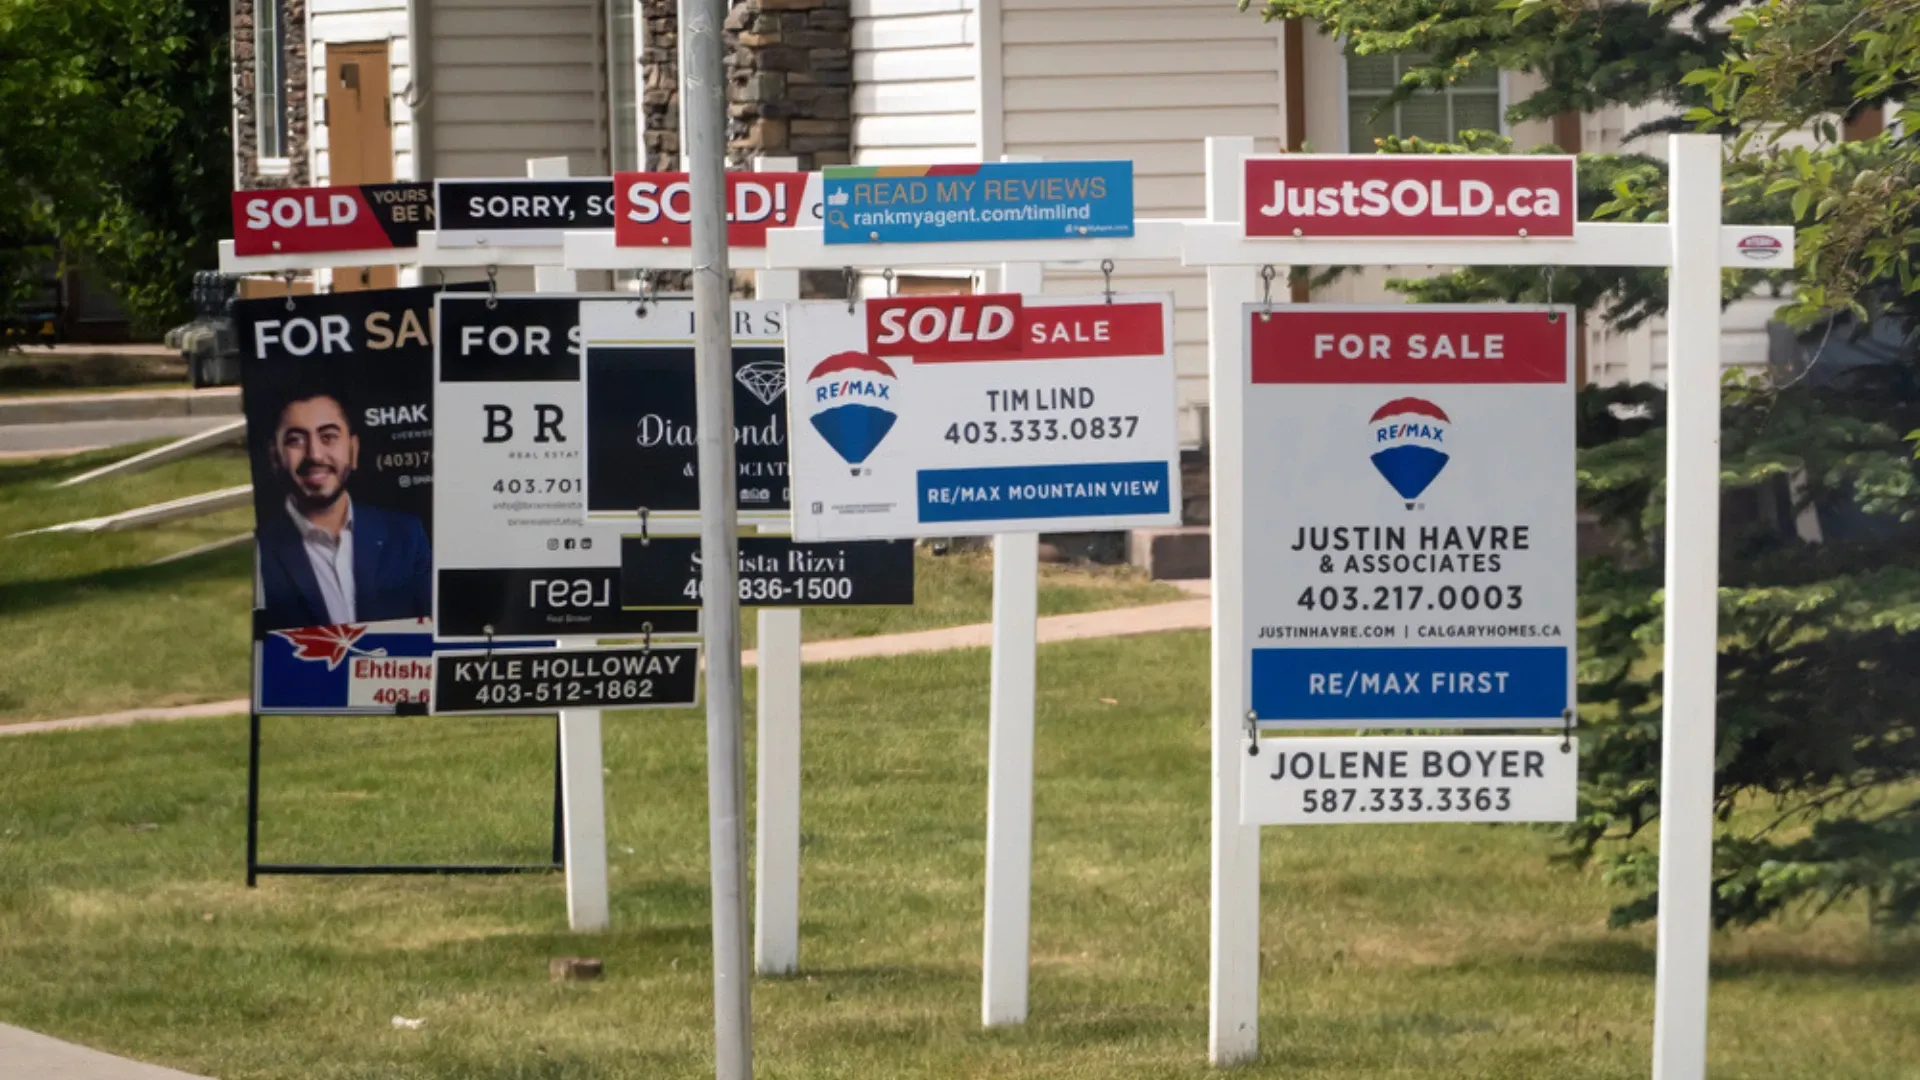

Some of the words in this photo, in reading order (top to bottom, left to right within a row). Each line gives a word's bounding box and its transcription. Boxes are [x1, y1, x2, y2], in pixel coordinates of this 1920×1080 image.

[372, 189, 428, 204] YOURS
[627, 181, 788, 223] SOD!
[854, 183, 927, 205] READ
[937, 180, 976, 204] MY
[985, 177, 1107, 201] REVIEWS
[1259, 179, 1561, 217] JustSOLD.ca
[246, 194, 358, 230] SOLD
[392, 204, 419, 223] BE
[468, 195, 576, 221] SORRY,
[853, 203, 1091, 228] rankmyagent.com/timlind
[254, 315, 353, 359] FOR
[876, 304, 1015, 344] SOLD
[1031, 320, 1111, 343] SALE
[461, 325, 551, 355] FOR
[1314, 334, 1391, 359] FOR
[1408, 334, 1504, 359] SALE
[816, 379, 890, 403] RE/MAX
[986, 389, 1029, 412] TIM
[1036, 387, 1095, 411] LIND
[944, 416, 1139, 445] 403.333.0837
[1377, 423, 1444, 442] RE/MAX
[683, 462, 695, 477] &
[493, 478, 582, 494] 403.701
[927, 485, 1001, 505] RE/MAX
[1009, 482, 1107, 501] MOUNTAIN
[1111, 480, 1160, 498] VIEW
[1291, 526, 1406, 551] JUSTIN
[1420, 525, 1530, 550] HAVRE
[788, 550, 845, 573] Rizvi
[1319, 554, 1334, 573] &
[1344, 553, 1502, 573] ASSOCIATES
[1297, 585, 1523, 611] 403.217.0003
[1258, 626, 1395, 638] JUSTINHAVRE.COM
[1418, 625, 1561, 638] CALGARYHOMES.CA
[455, 660, 522, 682] KYLE
[532, 655, 681, 679] HOLLOWAY
[475, 678, 653, 704] 403-512-1862
[1309, 671, 1420, 697] RE/MAX
[1432, 671, 1510, 694] FIRST
[1270, 751, 1408, 780] JOLENE
[1423, 750, 1545, 779] BOYER
[1303, 787, 1512, 813] 587.333.3363
